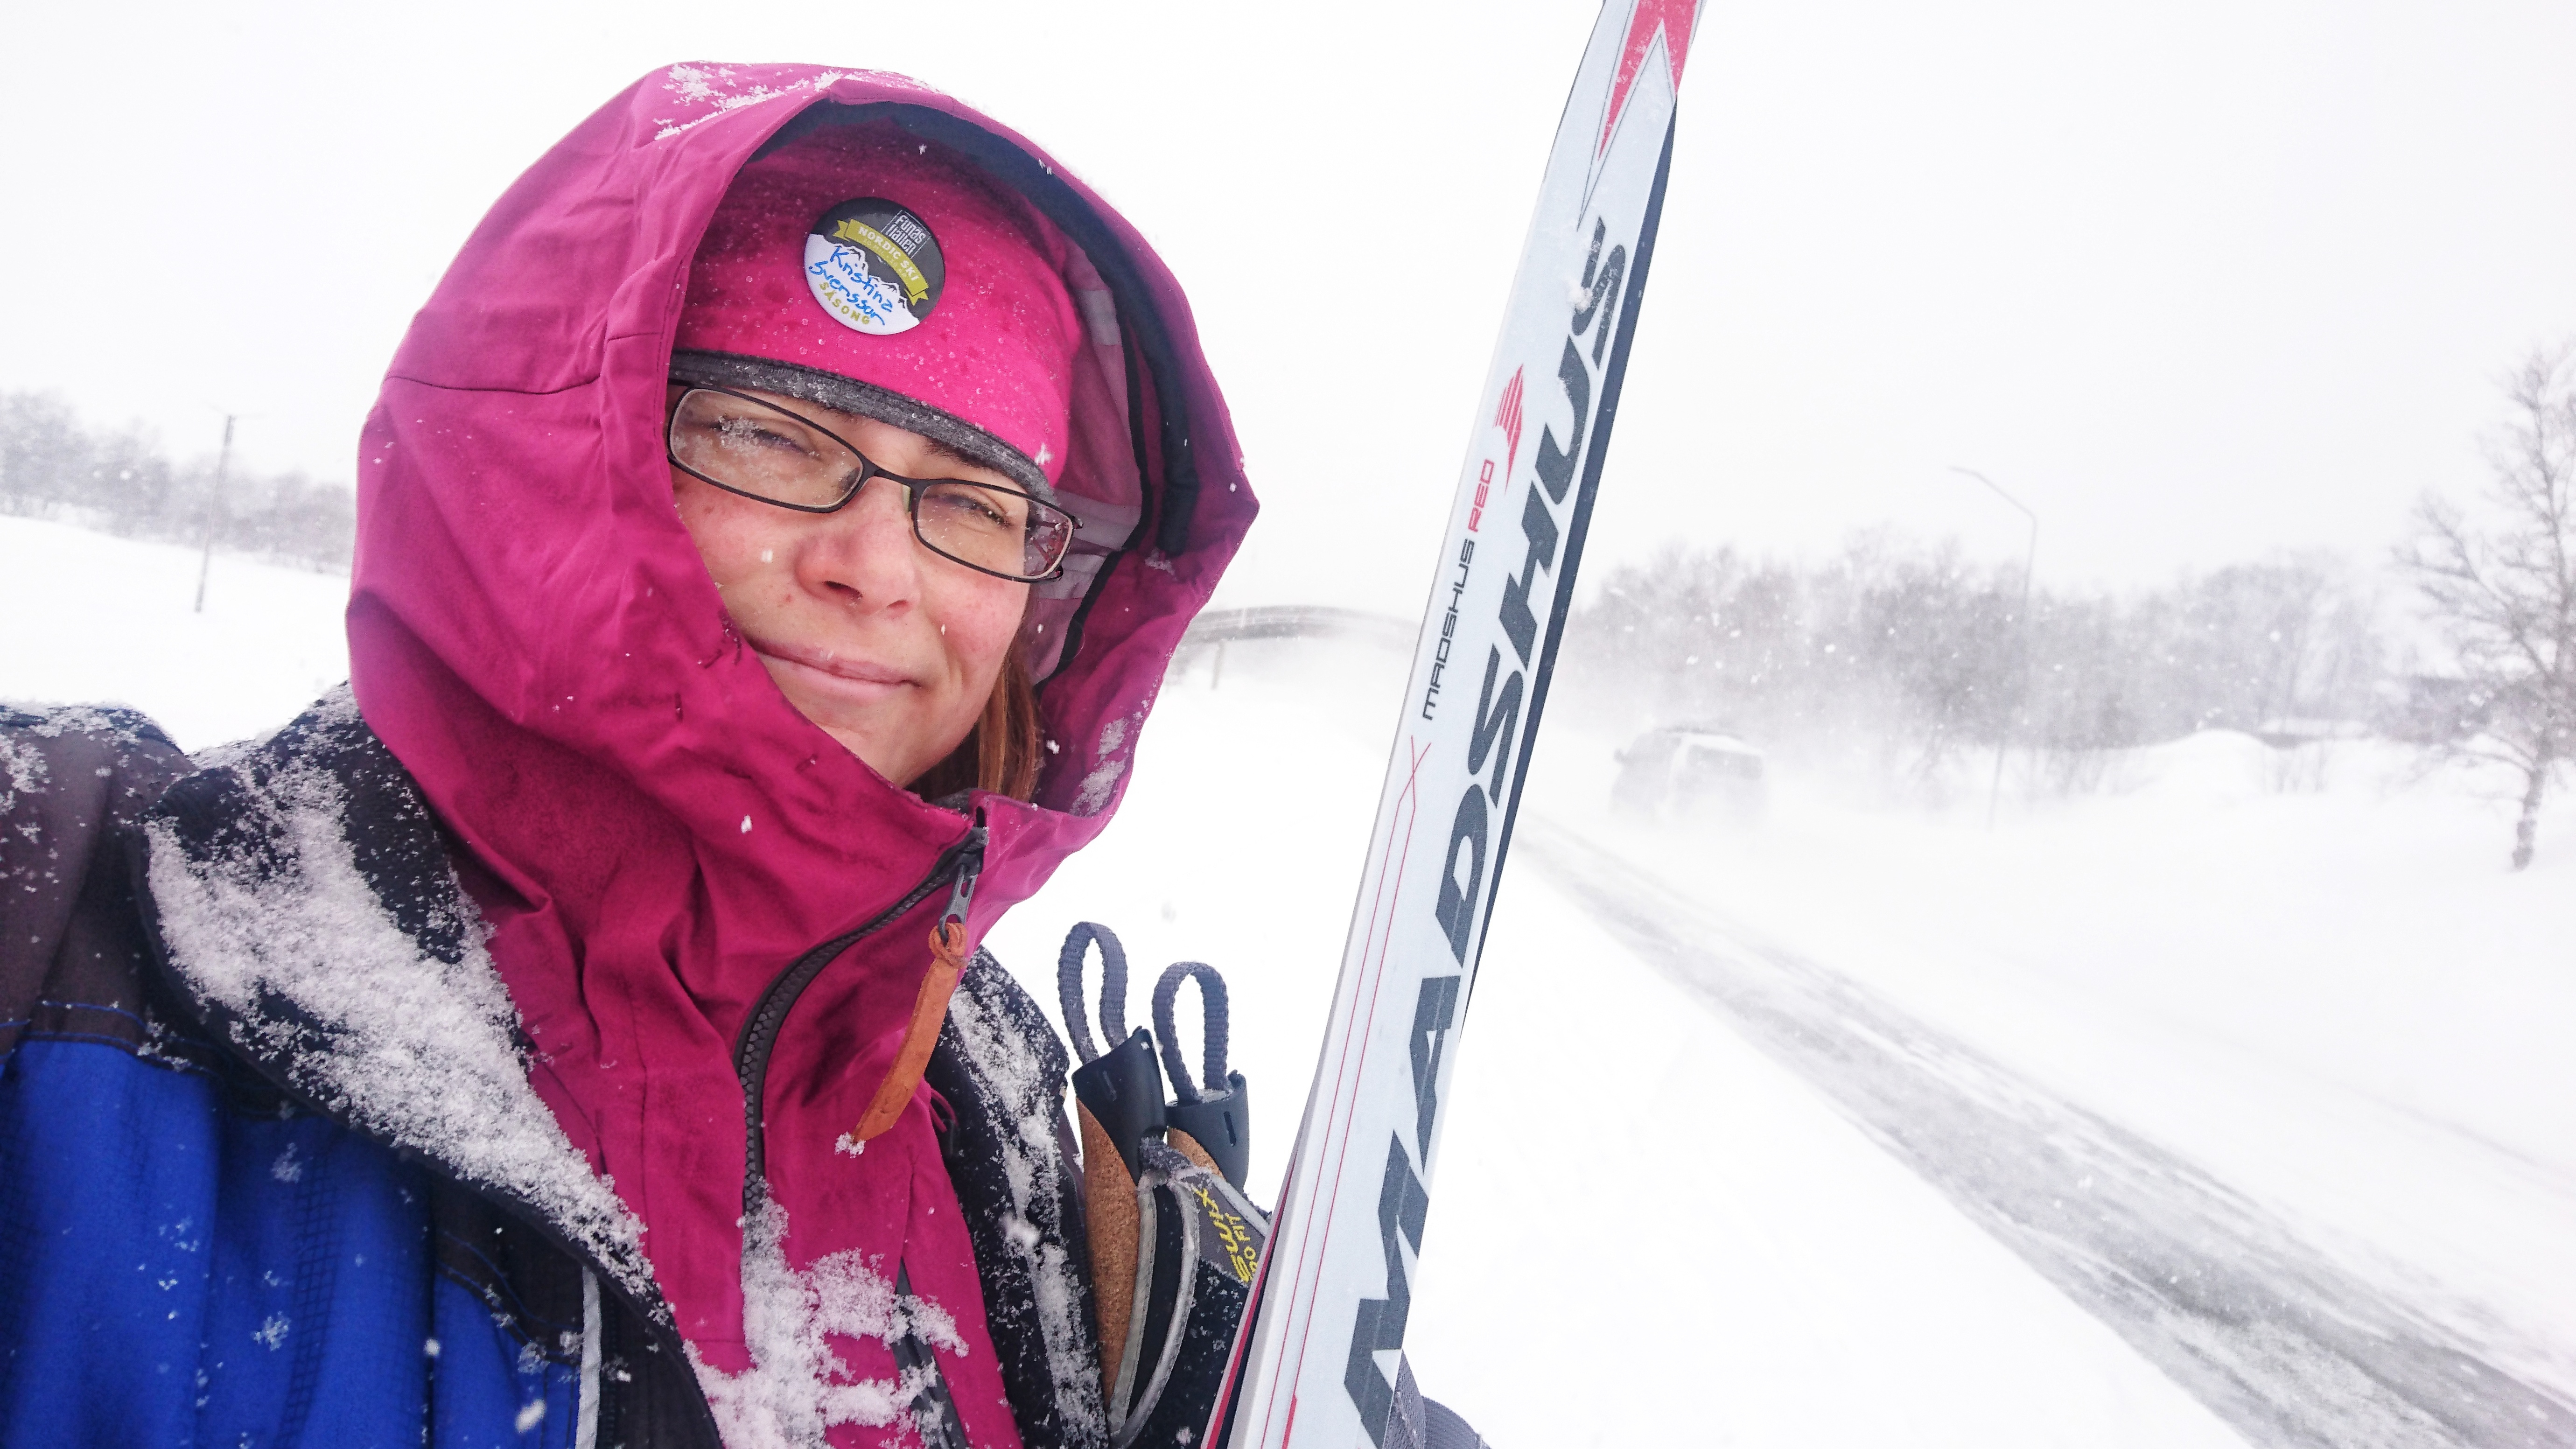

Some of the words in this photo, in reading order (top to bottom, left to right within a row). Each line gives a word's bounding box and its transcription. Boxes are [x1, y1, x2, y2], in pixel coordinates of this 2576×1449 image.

[858, 226, 901, 259] NORDIC
[900, 260, 919, 281] SKI
[1422, 539, 1475, 721] MADSHUS
[1468, 459, 1495, 532] RED
[1344, 215, 1626, 1449] MADSHUS
[1225, 1212, 1251, 1242] FIT
